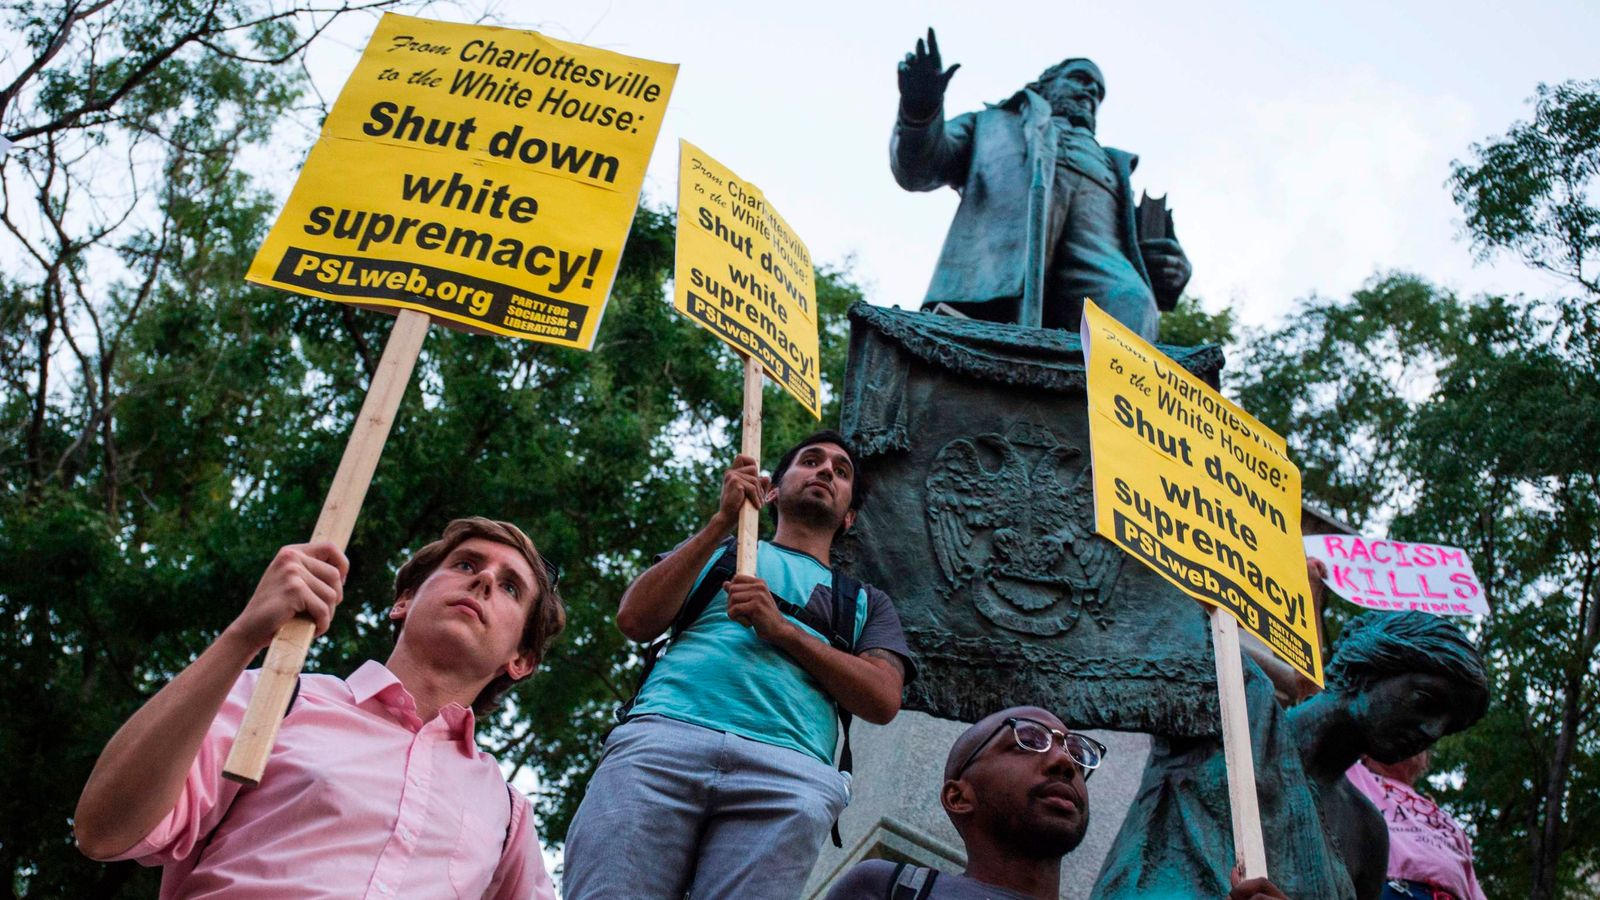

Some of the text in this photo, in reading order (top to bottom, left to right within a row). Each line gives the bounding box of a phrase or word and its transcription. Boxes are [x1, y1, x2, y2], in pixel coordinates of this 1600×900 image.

[378, 67, 645, 134] to the White House:
[387, 35, 661, 103] From Charlottesville
[362, 101, 620, 183] Shut down
[402, 173, 539, 224] white
[692, 158, 809, 267] From Charlttesville
[694, 183, 808, 286] to the White House:
[293, 254, 494, 316] PSLweb.org
[303, 206, 603, 294] supremacy!
[699, 206, 808, 314] Shut down
[503, 316, 567, 336] LIBERATION
[507, 305, 578, 329] SOCIALISM &
[510, 294, 569, 317] PARTY FOR
[690, 267, 815, 379] supremacy!
[728, 264, 788, 325] white
[694, 297, 783, 375] PSLweb.org
[1110, 357, 1288, 492] to the White House:
[1154, 360, 1289, 462] Charlottes
[1114, 394, 1287, 534] Shut down
[1160, 475, 1258, 552] white
[1323, 535, 1464, 568] RACISM
[1114, 477, 1307, 629] supremacy!
[1125, 520, 1260, 630] PSLweb.org
[1332, 564, 1479, 599] KILLS
